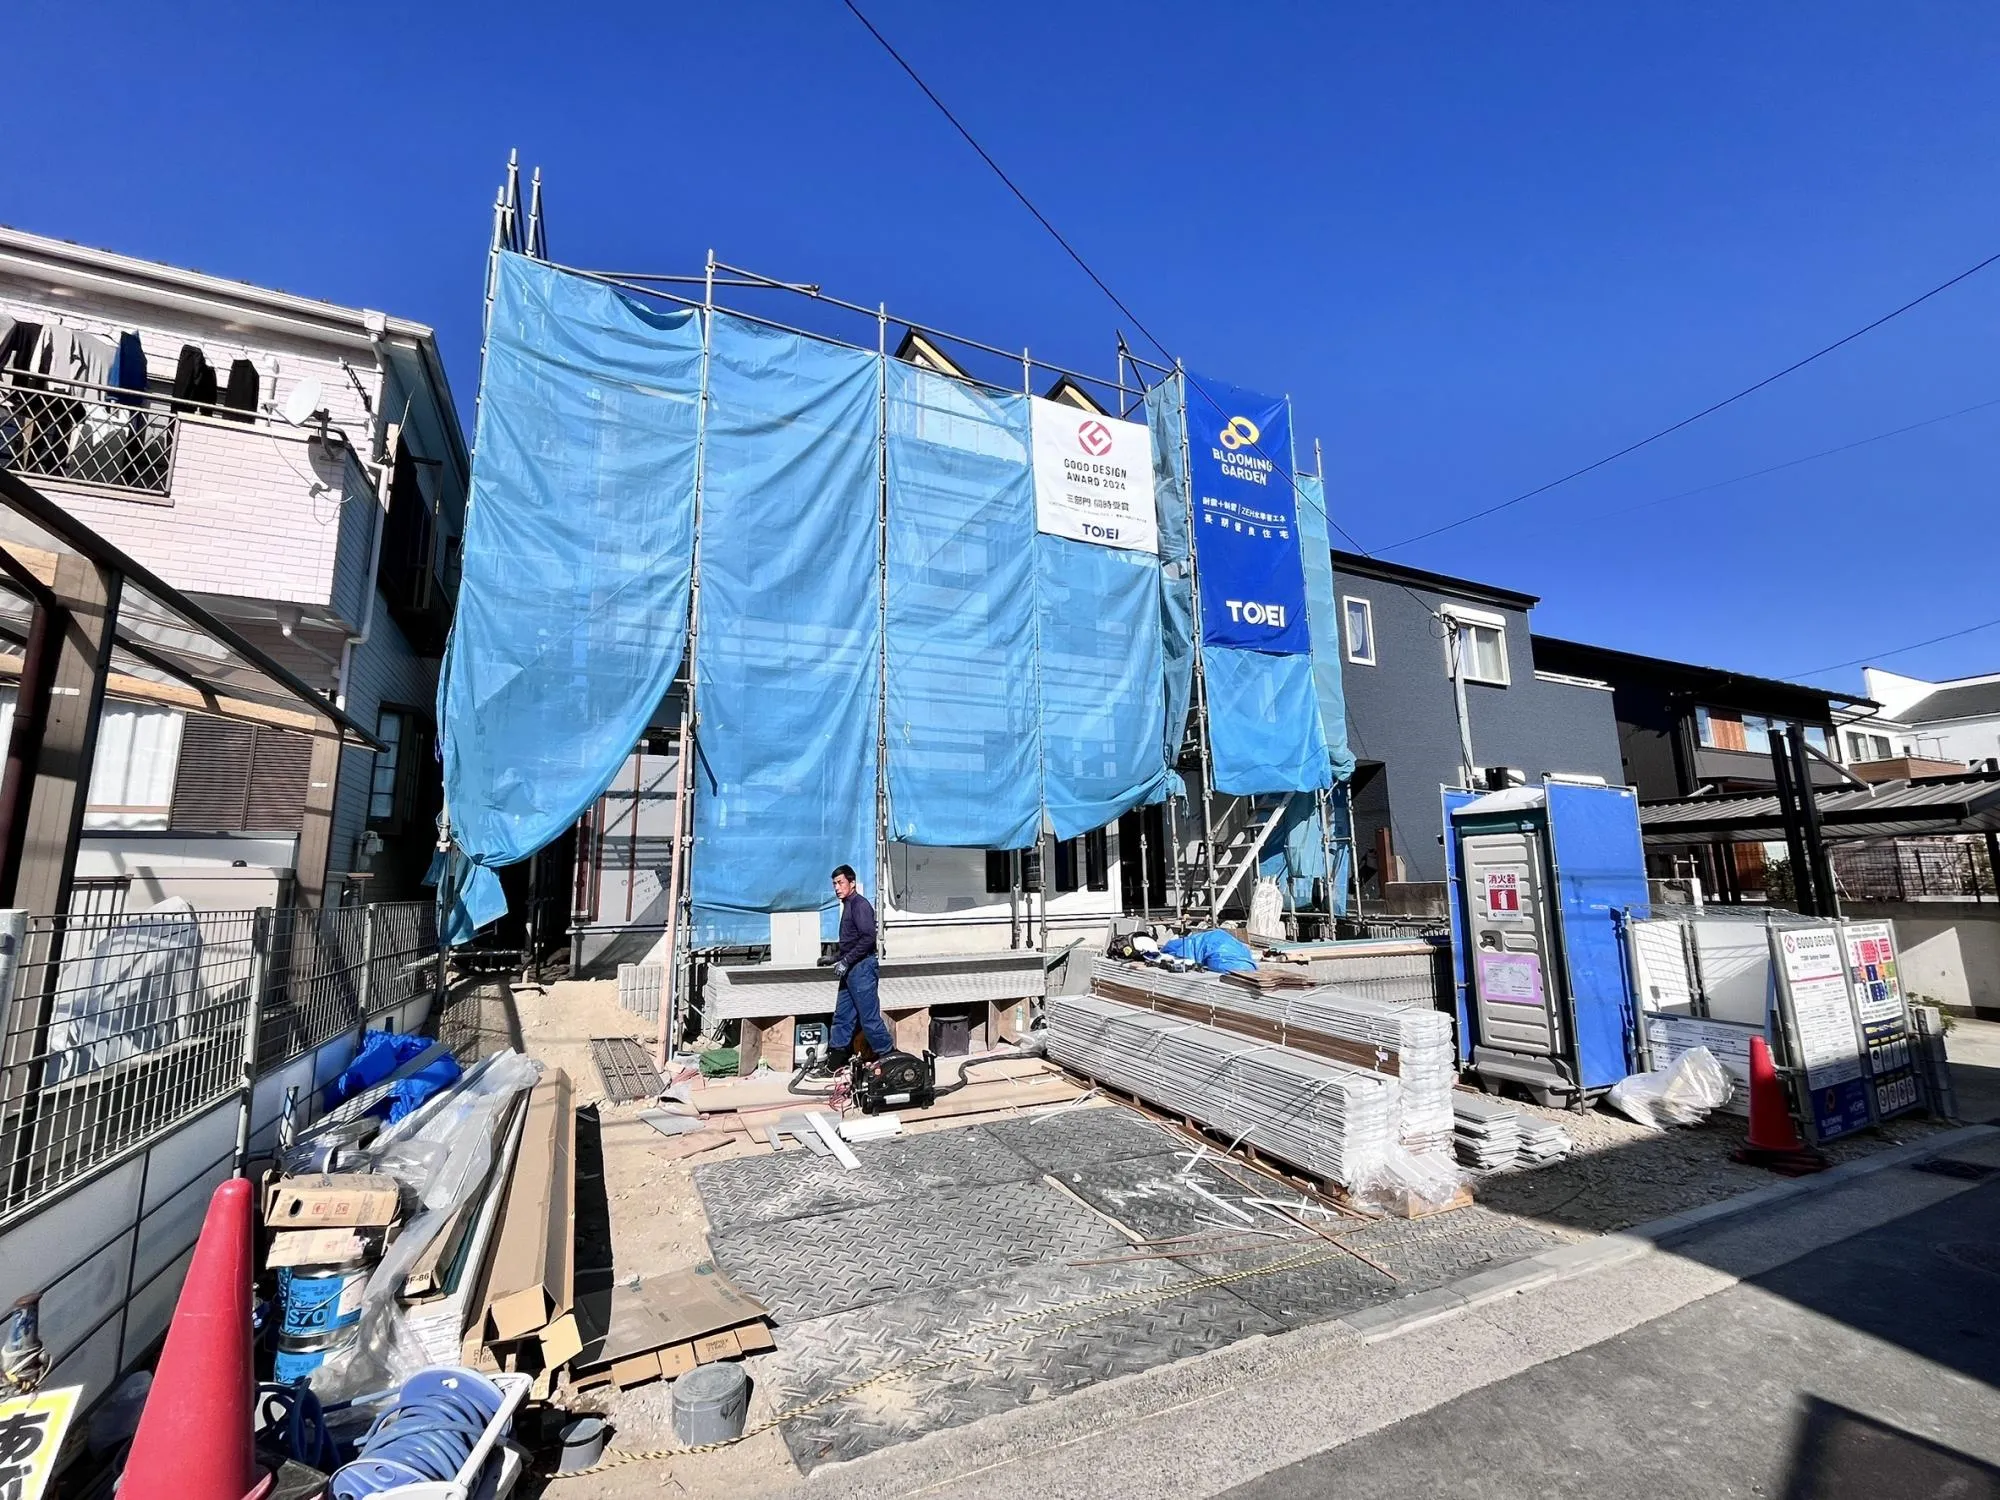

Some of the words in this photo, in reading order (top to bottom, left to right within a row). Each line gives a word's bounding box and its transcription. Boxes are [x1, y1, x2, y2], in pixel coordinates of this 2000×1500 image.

[1064, 458, 1090, 472] GOOD
[1092, 464, 1127, 479] DESIGN
[1211, 447, 1273, 472] BLOOMING
[1066, 471, 1100, 487] AWARD
[1102, 478, 1126, 491] 2024
[1221, 463, 1267, 486] GARDEN
[1225, 600, 1286, 628] TOEI
[1488, 873, 1516, 884] 消火器
[1796, 936, 1815, 949] GOOD
